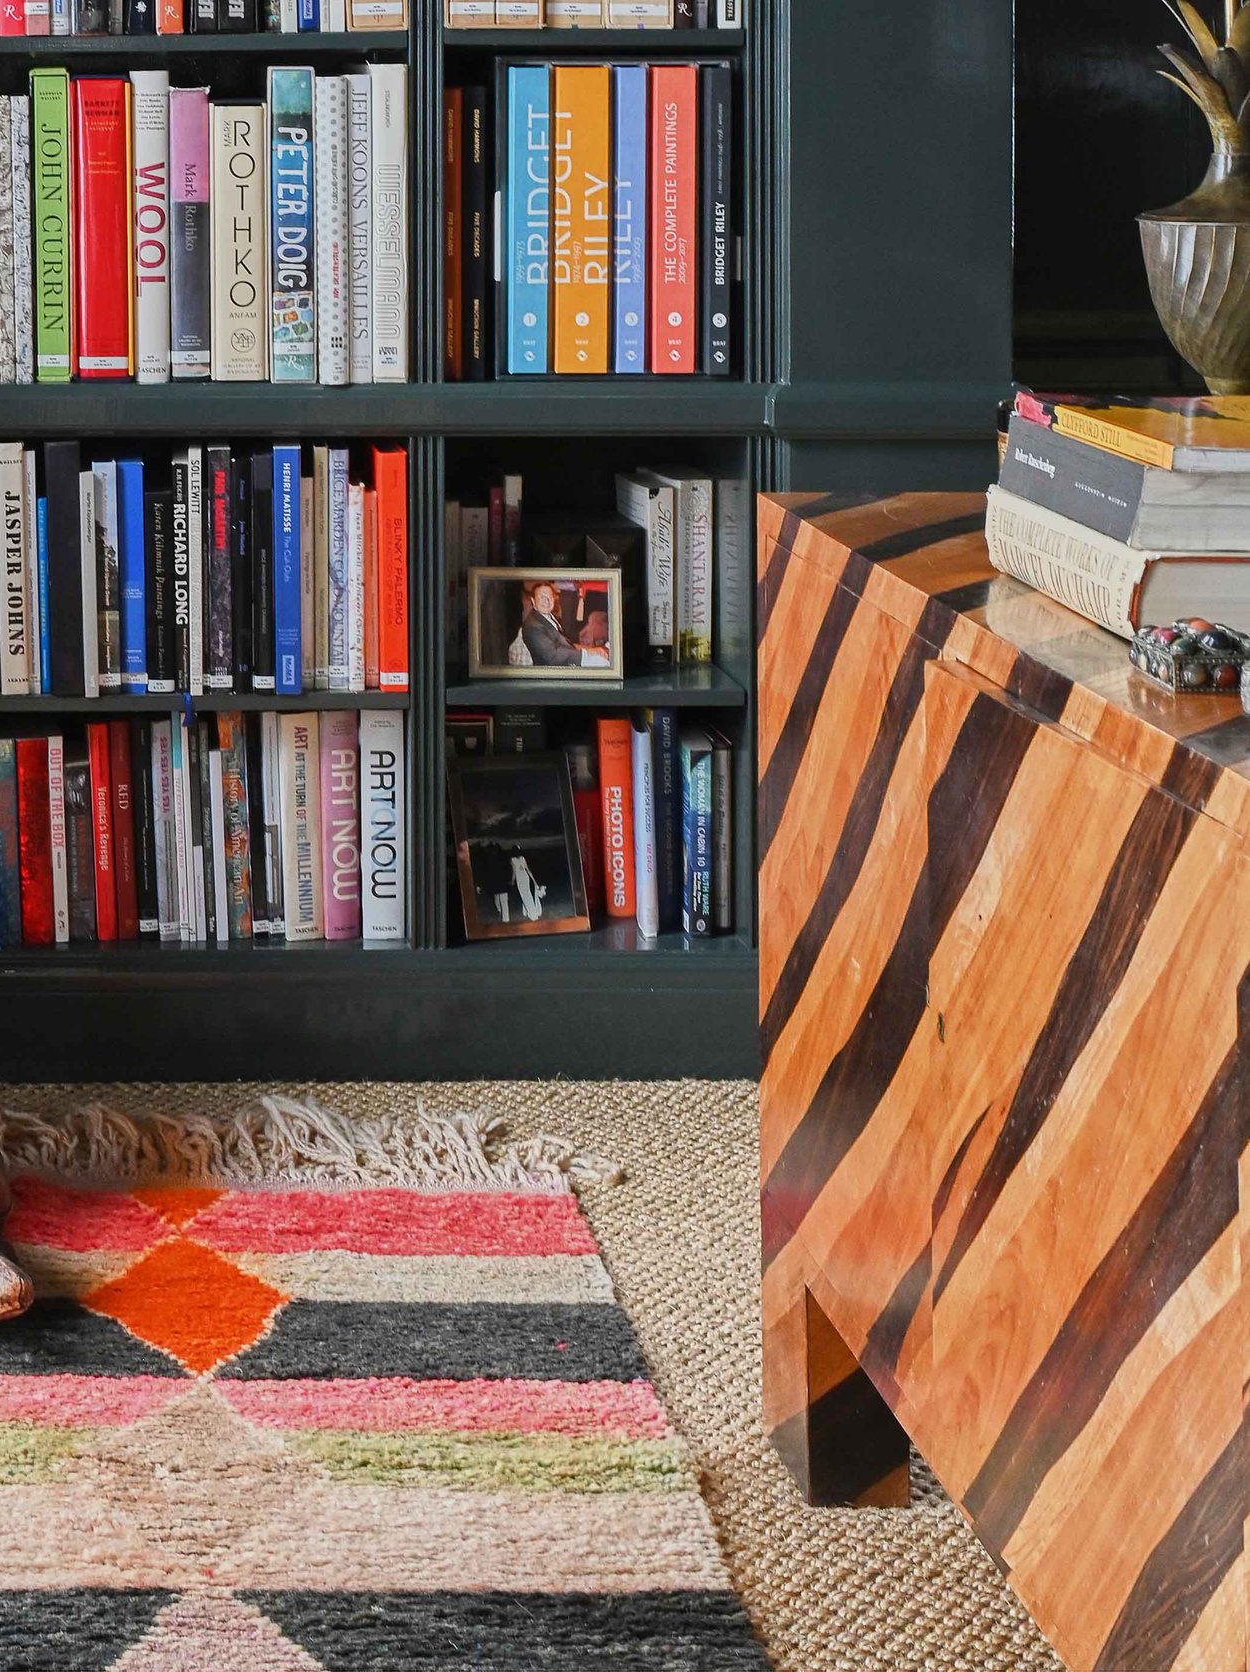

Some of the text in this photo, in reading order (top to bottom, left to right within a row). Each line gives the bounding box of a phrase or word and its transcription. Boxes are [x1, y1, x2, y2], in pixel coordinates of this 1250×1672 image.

[40, 122, 65, 333] JOHN CURRIN
[134, 161, 167, 299] WOOL
[184, 162, 197, 252] Mark Rothko
[229, 120, 257, 308] ROTHKO
[351, 87, 369, 341] JEFF KOONS VERSAILLES
[376, 162, 402, 340] WESSELMANN
[664, 102, 679, 284] THE COMPLETE PAINTINGS
[714, 200, 726, 285] BRIDGET RILEY
[277, 226, 308, 288] DOIG
[1061, 412, 1122, 448] CLYFFORD STILL
[282, 461, 293, 533] HENRI MATISSE
[658, 501, 673, 588] Ahab's Wife
[5, 490, 25, 656] JASPER JOHNS
[173, 502, 188, 625] RICHARD LONG
[691, 512, 708, 625] SHANTARAM
[998, 539, 1112, 627] MARCEL DUCHAMP
[49, 747, 65, 848] OUT OF THE BOX
[96, 785, 110, 871] Veronica's Revenge
[117, 784, 128, 810] RED
[293, 725, 313, 923] ART AT THE TURN OF THE MILLENNIUM
[331, 749, 357, 901] ART NOW
[370, 749, 397, 899] ART NOW
[610, 785, 626, 908] PHOTO ICONS
